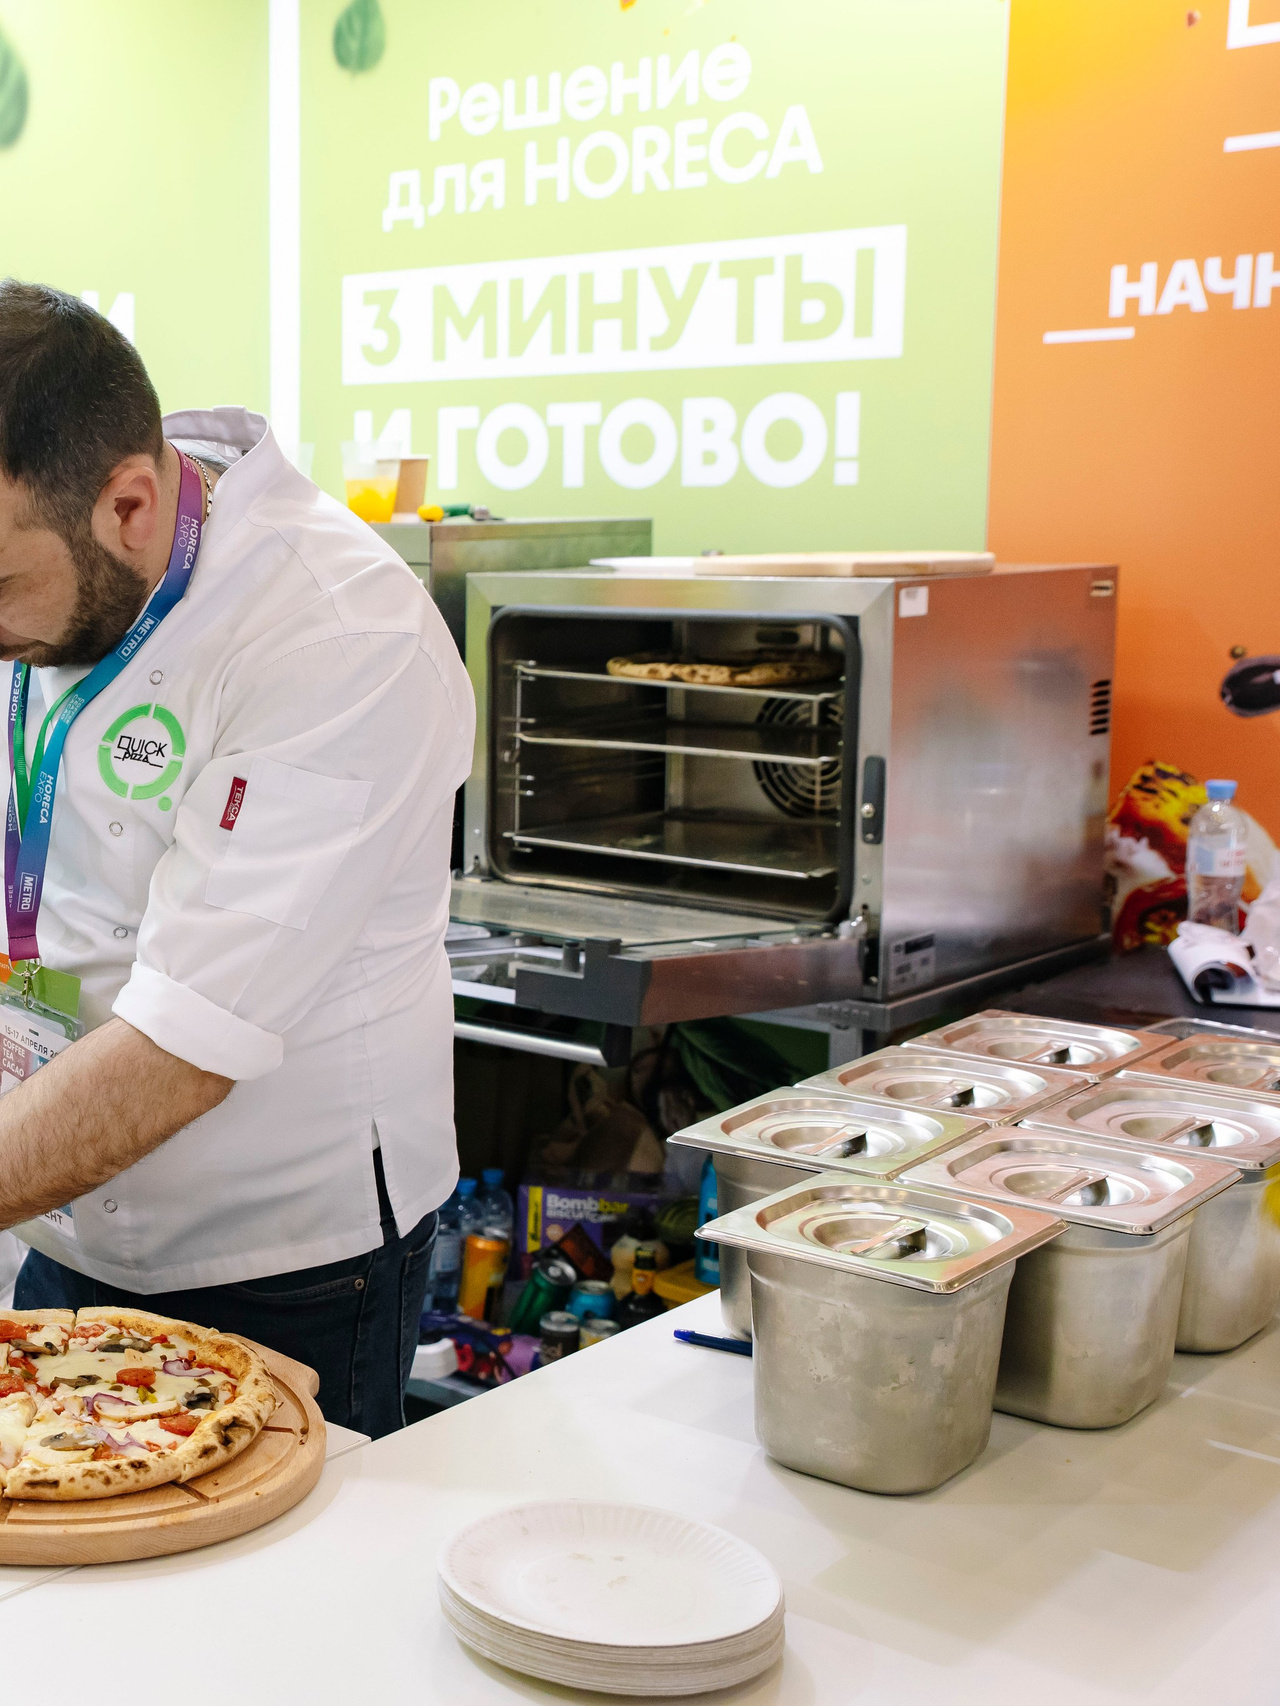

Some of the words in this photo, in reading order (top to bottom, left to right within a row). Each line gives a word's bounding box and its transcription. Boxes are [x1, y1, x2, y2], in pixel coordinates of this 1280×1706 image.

[428, 42, 752, 142] Решение
[382, 158, 506, 233] для
[524, 104, 824, 206] HORECA
[360, 286, 402, 367] 3
[431, 247, 877, 362] МИНУТЫ
[437, 391, 861, 491] ГОТОВО!
[178, 514, 191, 548] EXPO
[183, 518, 199, 570] HORECA
[121, 617, 155, 657] METRO
[10, 671, 22, 721] HORECA
[117, 735, 168, 758] QUICK
[34, 771, 47, 803] EXPO
[39, 775, 54, 824] HORECA
[21, 876, 35, 911] METRO
[3, 1038, 26, 1058] COFFEE
[3, 1048, 14, 1061] TEA
[5, 1025, 19, 1039] 15-17
[20, 1034, 48, 1056] АПРЕЛЯ
[2, 1058, 25, 1077] CACAO
[546, 1193, 629, 1213] Bombbar
